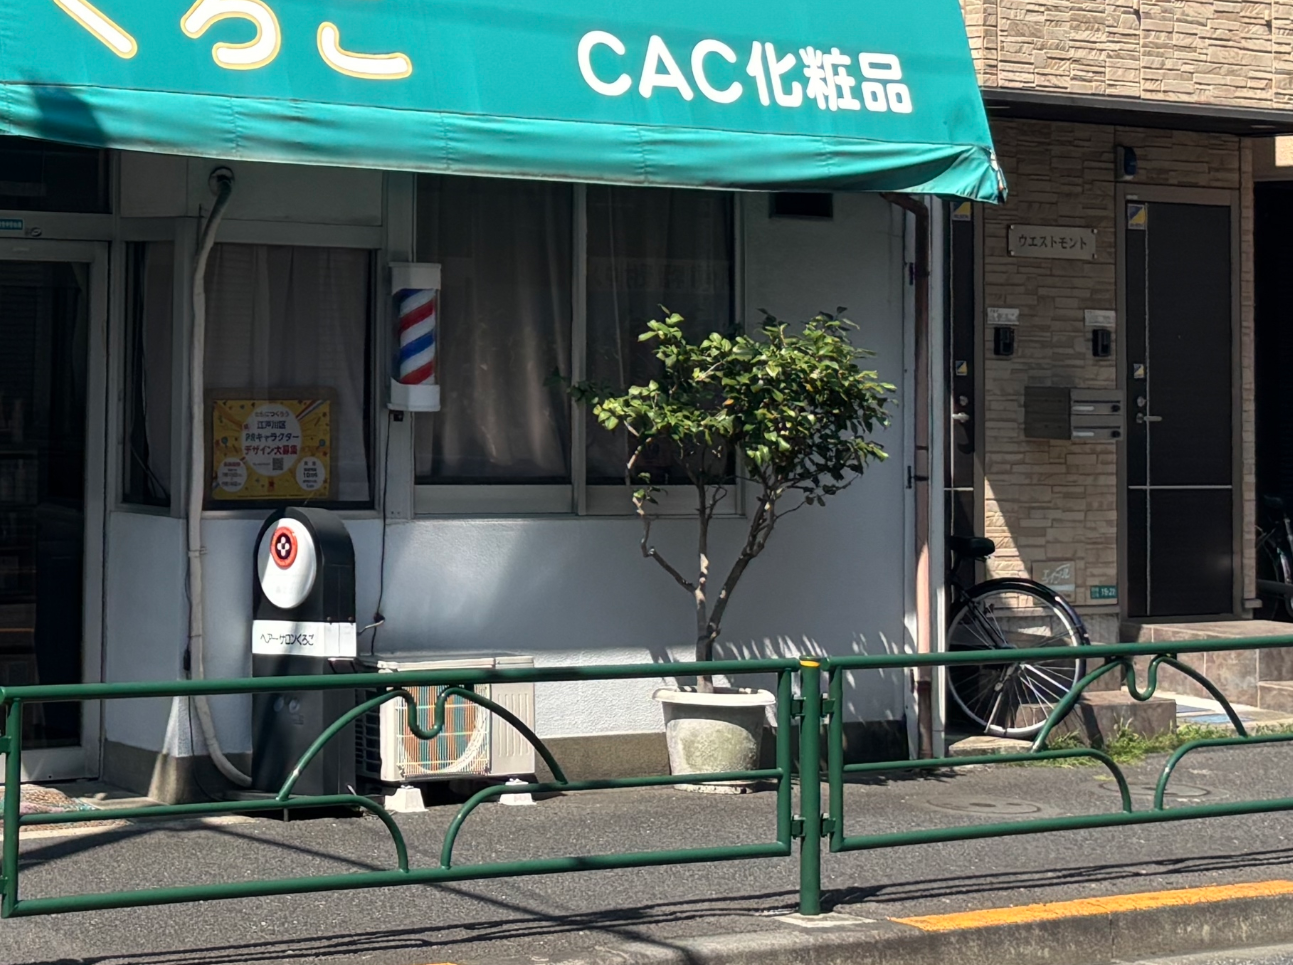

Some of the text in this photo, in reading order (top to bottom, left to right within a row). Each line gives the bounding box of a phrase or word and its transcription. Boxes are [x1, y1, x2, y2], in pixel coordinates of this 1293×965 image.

[576, 29, 913, 114] CAC化粧品
[1017, 234, 1087, 250] ウエストモント
[260, 633, 315, 646] ヘアーサロンくろご
